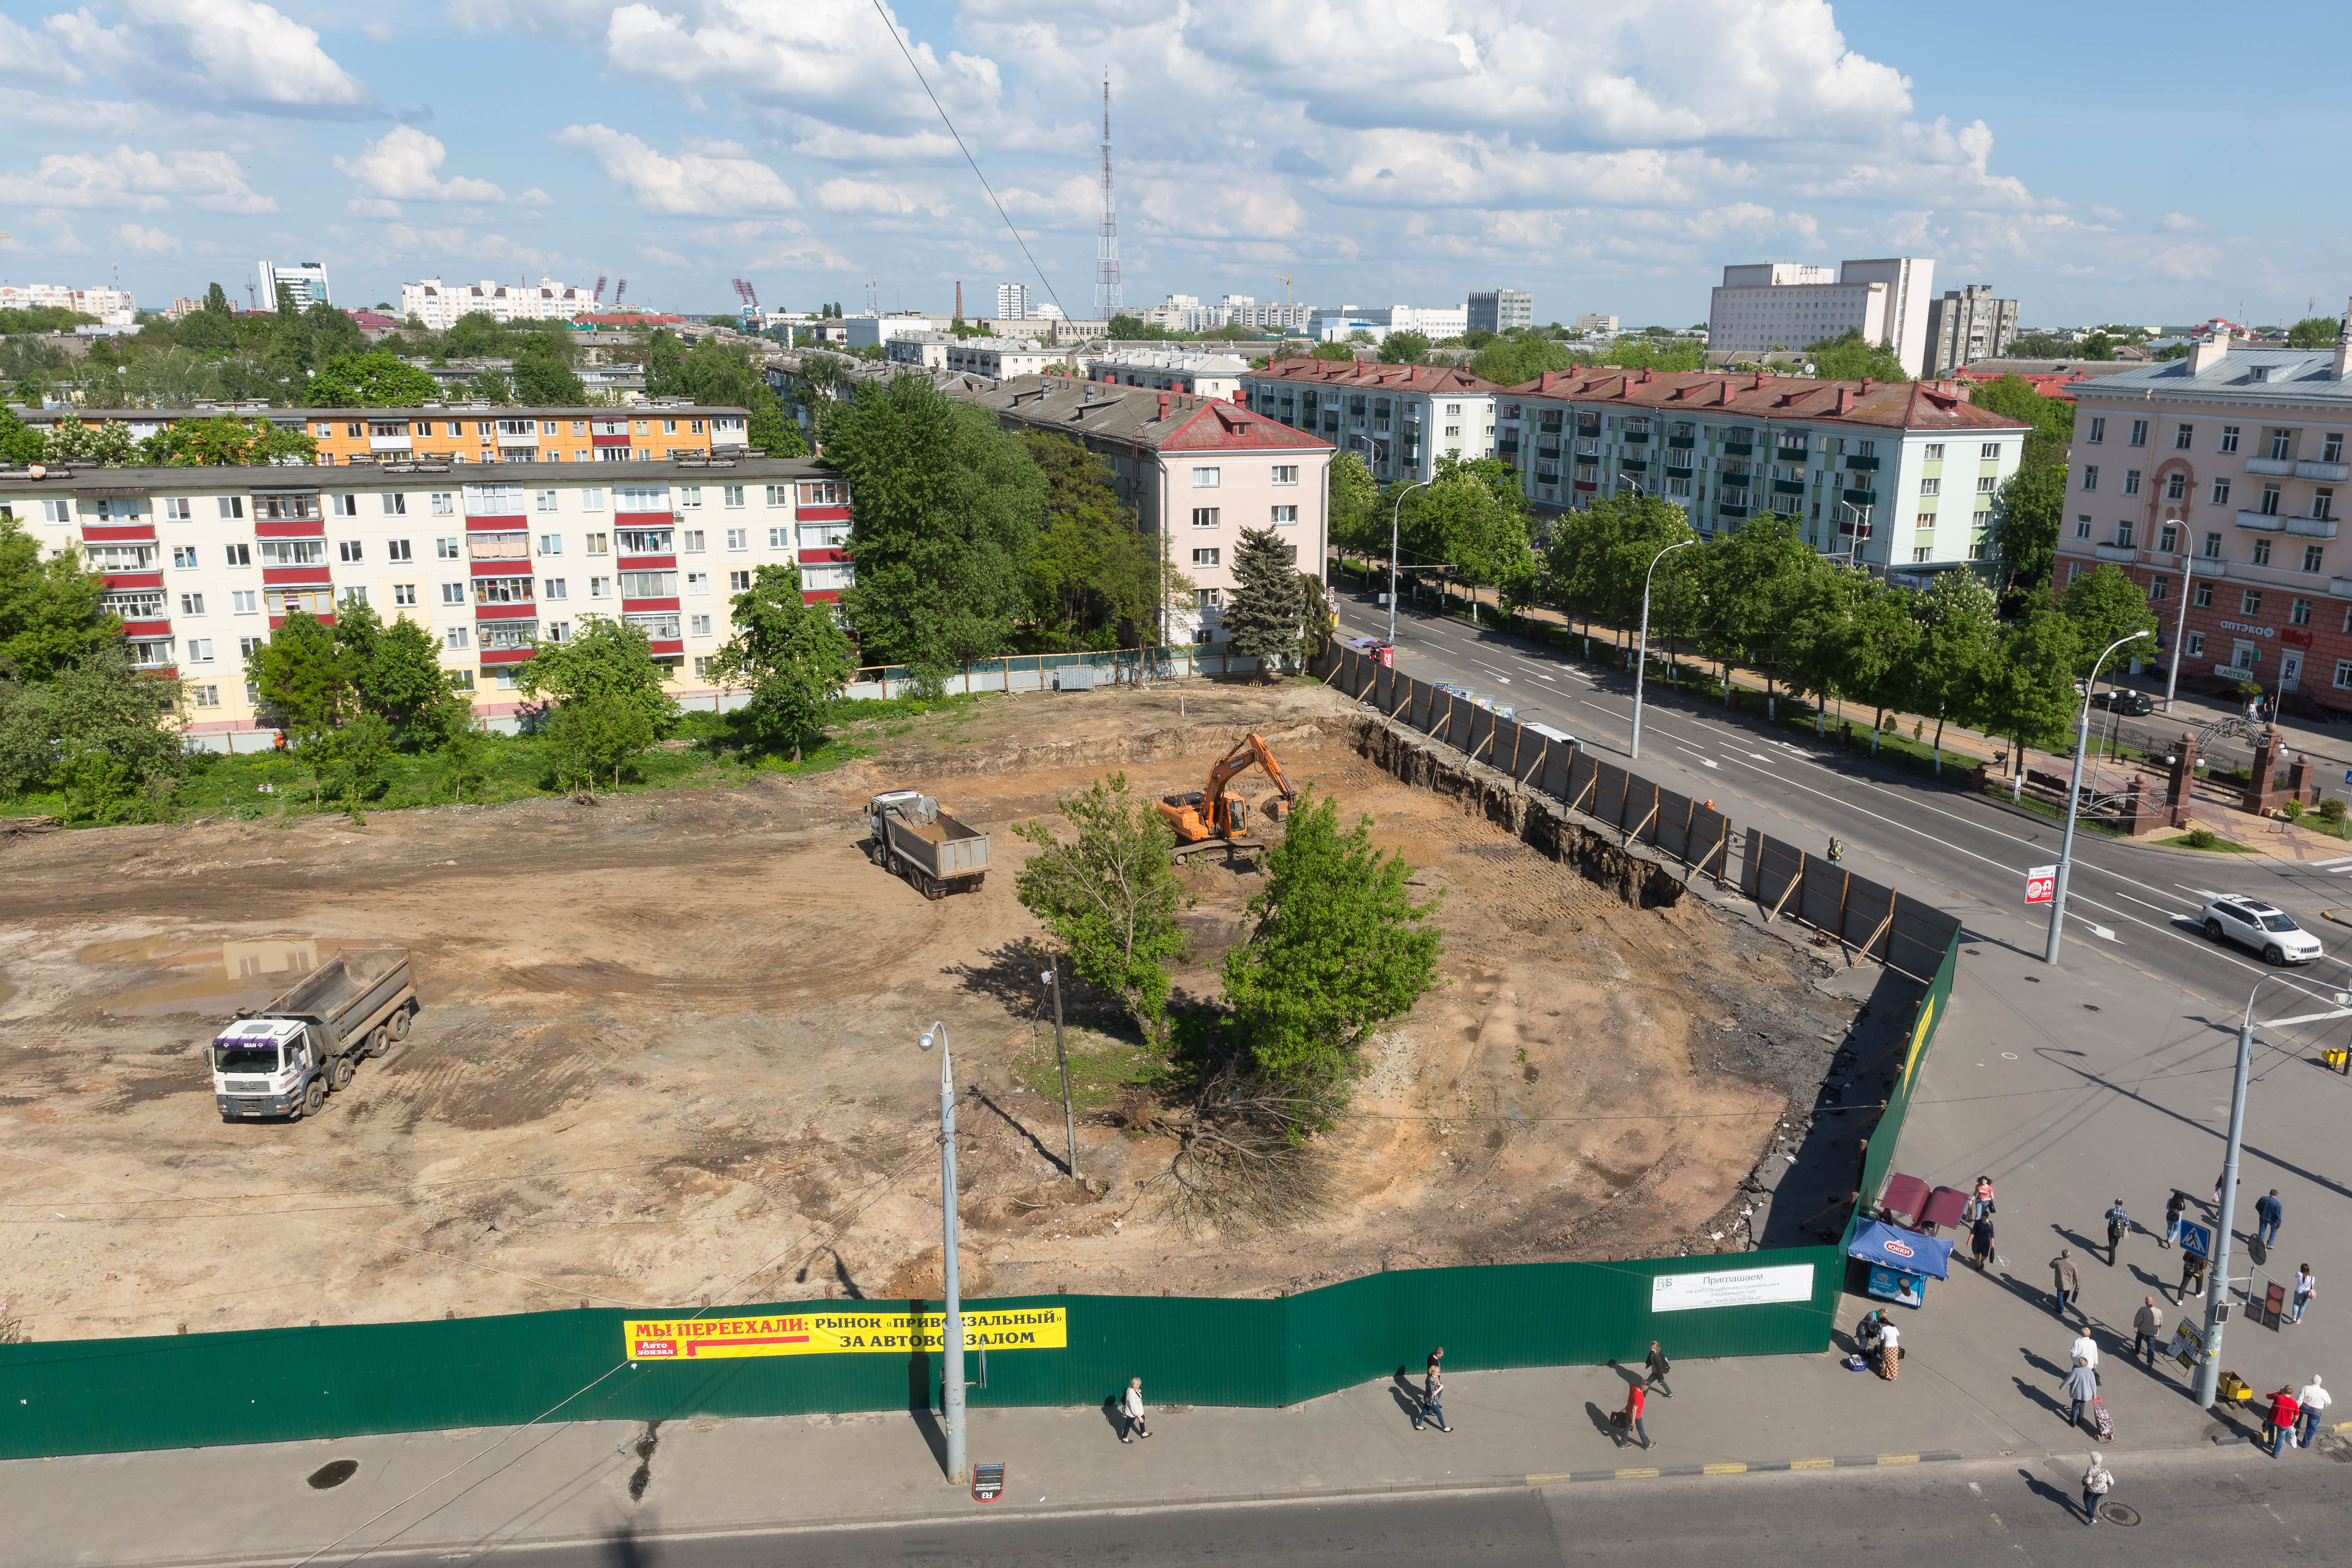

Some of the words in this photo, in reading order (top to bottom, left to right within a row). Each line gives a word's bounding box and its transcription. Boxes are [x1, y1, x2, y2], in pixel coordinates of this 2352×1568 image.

[1800, 266, 1818, 274] 2019
[2220, 620, 2264, 635] аптэка
[2222, 669, 2251, 680] АПТЕКА
[1230, 758, 1243, 769] DOOSAN
[1888, 1244, 1910, 1255] ЮККИ
[1703, 1274, 1763, 1285] Приглашаем
[636, 1324, 672, 1337] МЫ
[677, 1318, 809, 1336] ПЕРЕЕХАЛИ:
[815, 1318, 881, 1329] РЫНОК
[840, 1335, 865, 1347] ЗА
[870, 1332, 1035, 1347] АВТОВОЗАЛОМ
[2179, 1324, 2197, 1345] МЕБЕЛЬ
[2190, 1341, 2199, 1354] ВЕС
